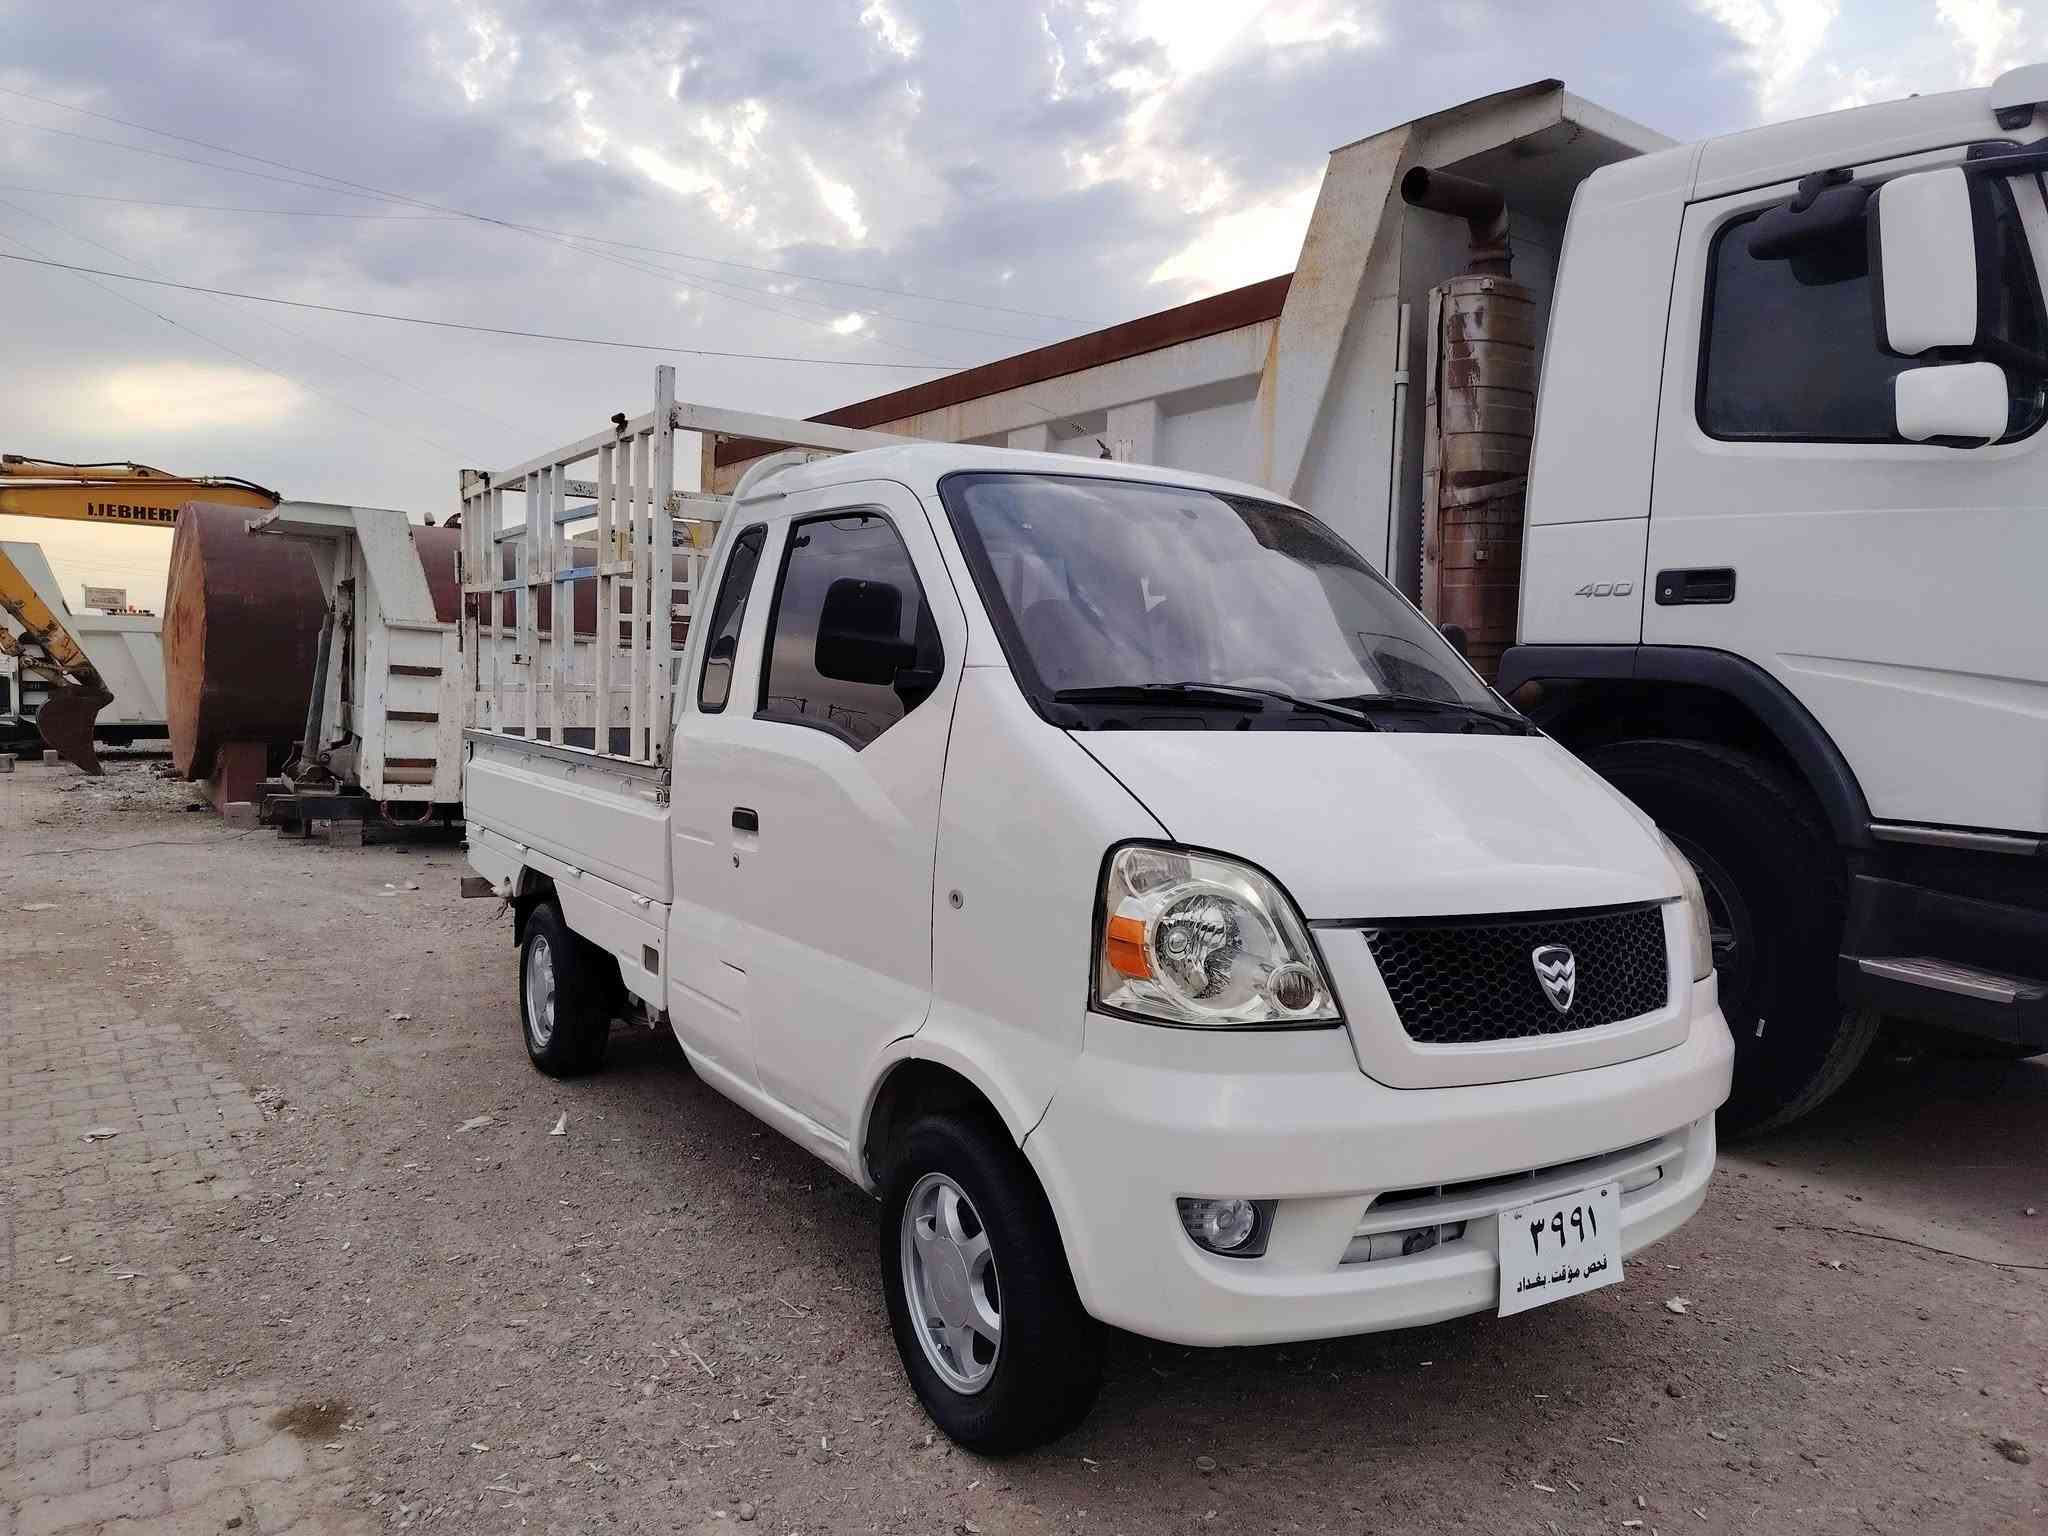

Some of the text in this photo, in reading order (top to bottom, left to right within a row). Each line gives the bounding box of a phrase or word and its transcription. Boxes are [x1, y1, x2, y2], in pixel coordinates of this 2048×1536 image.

[1574, 582, 1634, 598] 400
[1530, 1205, 1597, 1256] ٣٩٩١
[1583, 1254, 1608, 1278] فحص
[1517, 1273, 1546, 1292] بغداد
